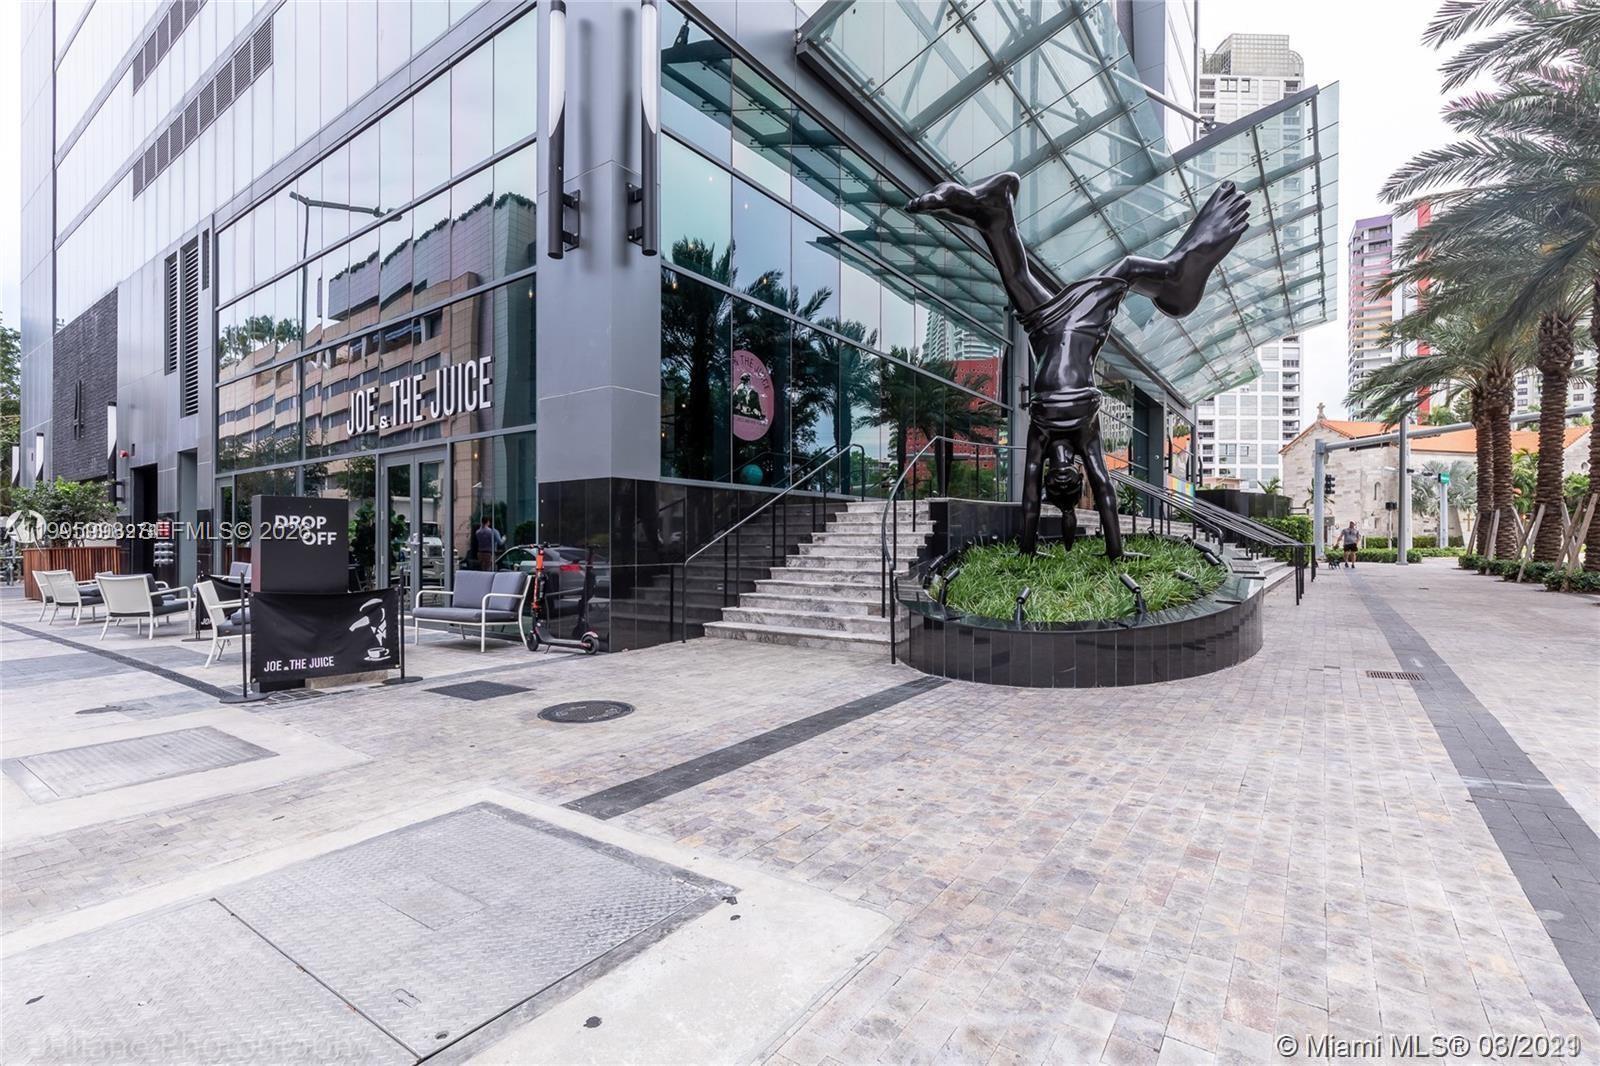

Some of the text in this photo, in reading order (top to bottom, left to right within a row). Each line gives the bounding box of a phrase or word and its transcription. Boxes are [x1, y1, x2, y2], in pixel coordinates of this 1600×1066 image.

[346, 355, 492, 435] JOE & THE JUICE
[274, 514, 328, 530] DROP
[302, 531, 338, 546] OFF
[263, 660, 282, 672] JOE
[289, 658, 307, 670] THE
[308, 655, 335, 668] JUICE
